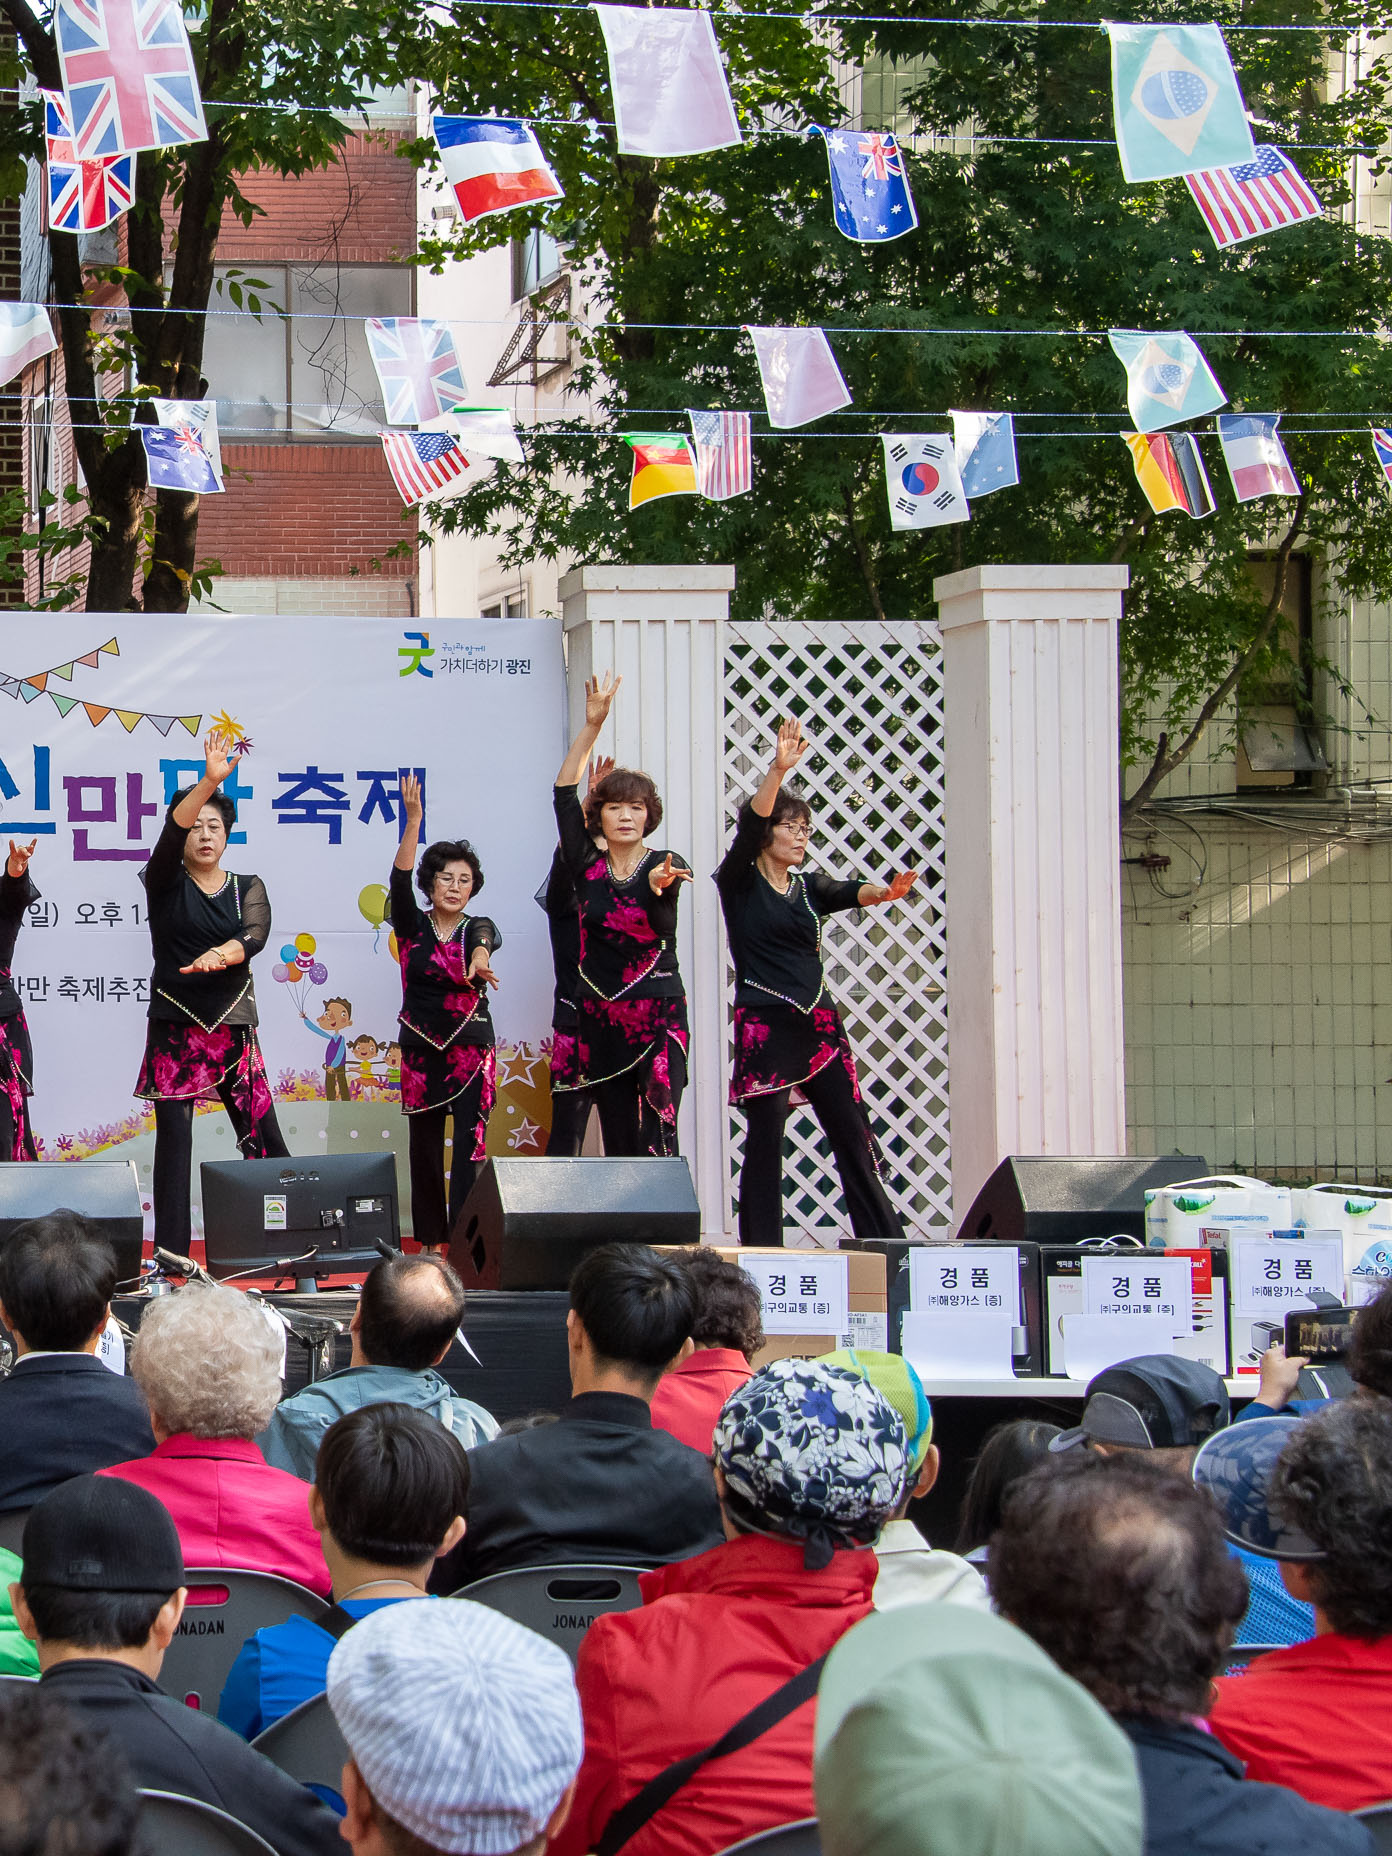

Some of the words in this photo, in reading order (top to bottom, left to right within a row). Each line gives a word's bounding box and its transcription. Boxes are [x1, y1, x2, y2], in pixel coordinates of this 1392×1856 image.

[440, 658, 504, 674] 가치더하기
[506, 659, 531, 674] 광진
[272, 766, 427, 845] 축제
[75, 902, 123, 927] 오후
[131, 904, 150, 926] 1
[940, 1267, 958, 1288] 경
[971, 1267, 989, 1288] 품
[1264, 1258, 1282, 1280] 경
[1294, 1259, 1313, 1280] 품
[768, 1275, 786, 1296] 경
[799, 1275, 818, 1296] 품
[1112, 1277, 1130, 1298] 경
[1143, 1277, 1162, 1298] 품
